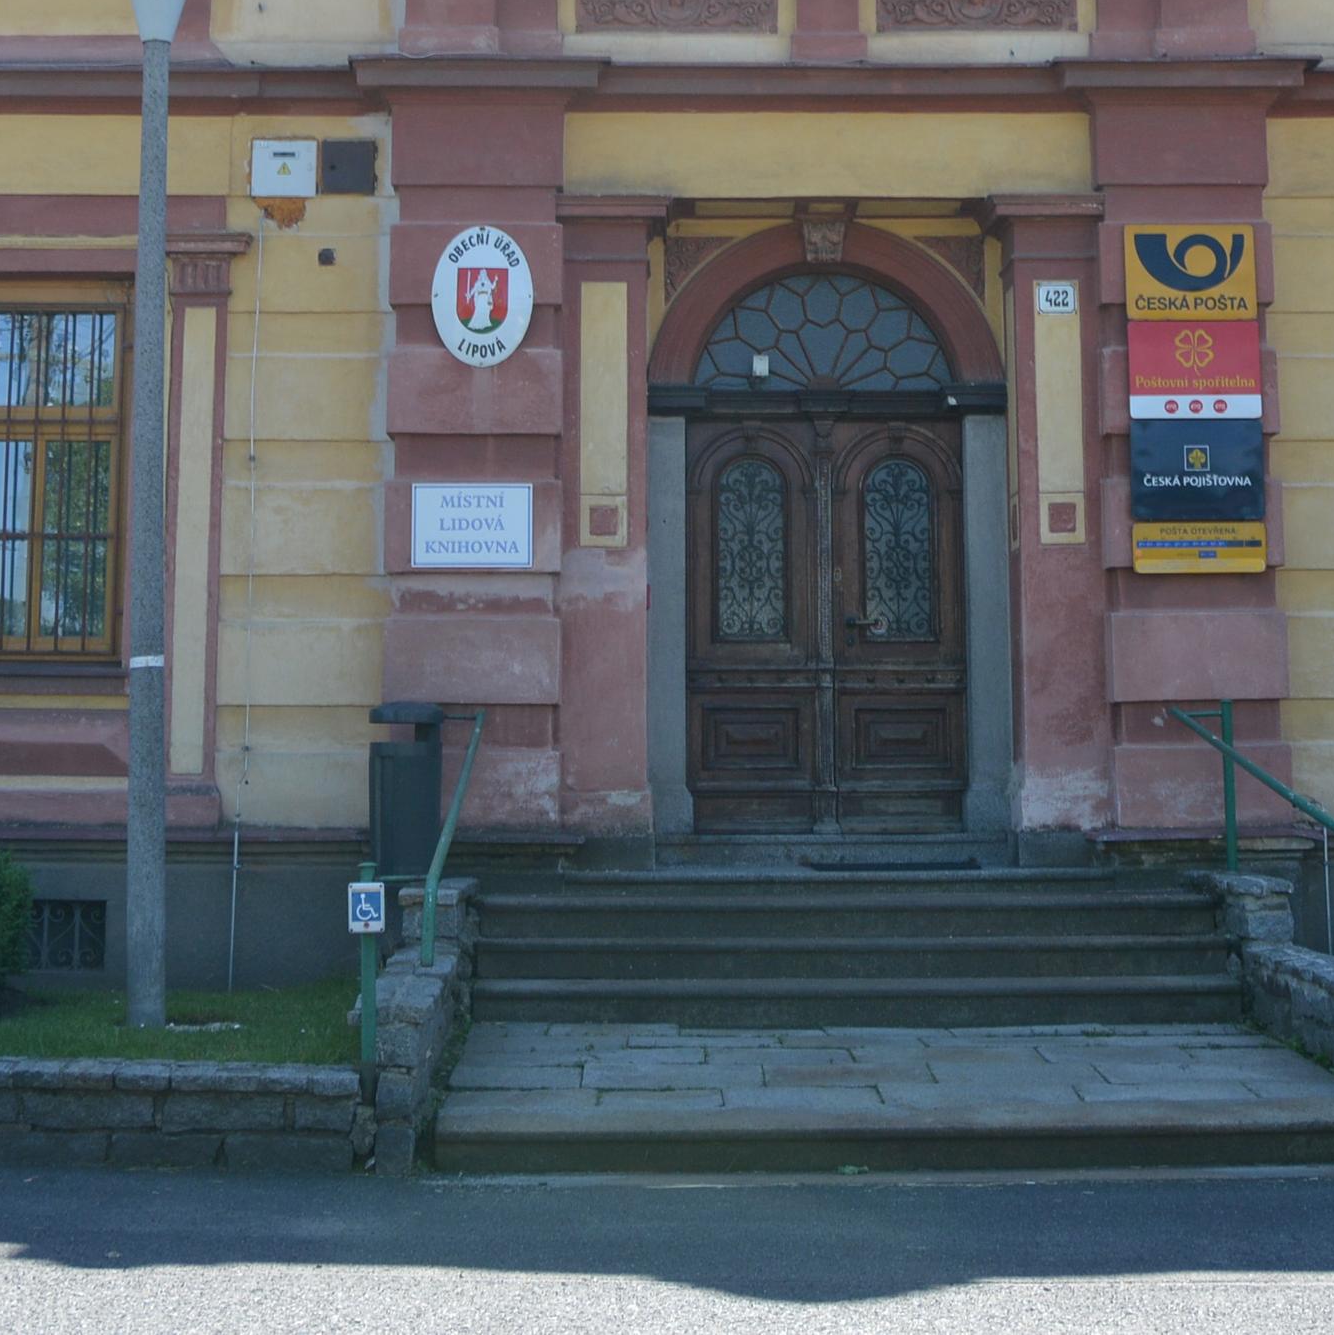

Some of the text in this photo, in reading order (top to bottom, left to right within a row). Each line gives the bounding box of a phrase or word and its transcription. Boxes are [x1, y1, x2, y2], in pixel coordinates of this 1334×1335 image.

[448, 230, 520, 268] OBECNÍ ÚŘAD
[1045, 290, 1069, 307] 422
[1134, 294, 1248, 311] ČESKÁ POŠTA
[457, 338, 506, 358] LIPOVÁ
[1135, 375, 1256, 390] Poštovní spořitelna
[1143, 473, 1252, 488] ČESKÁ POJIŠŤOVNA
[440, 491, 505, 508] MÍSTNÍ
[439, 514, 505, 531] LIDOVÁ
[1159, 526, 1188, 535] POŠTA
[425, 540, 520, 554] KNIHOVNA
